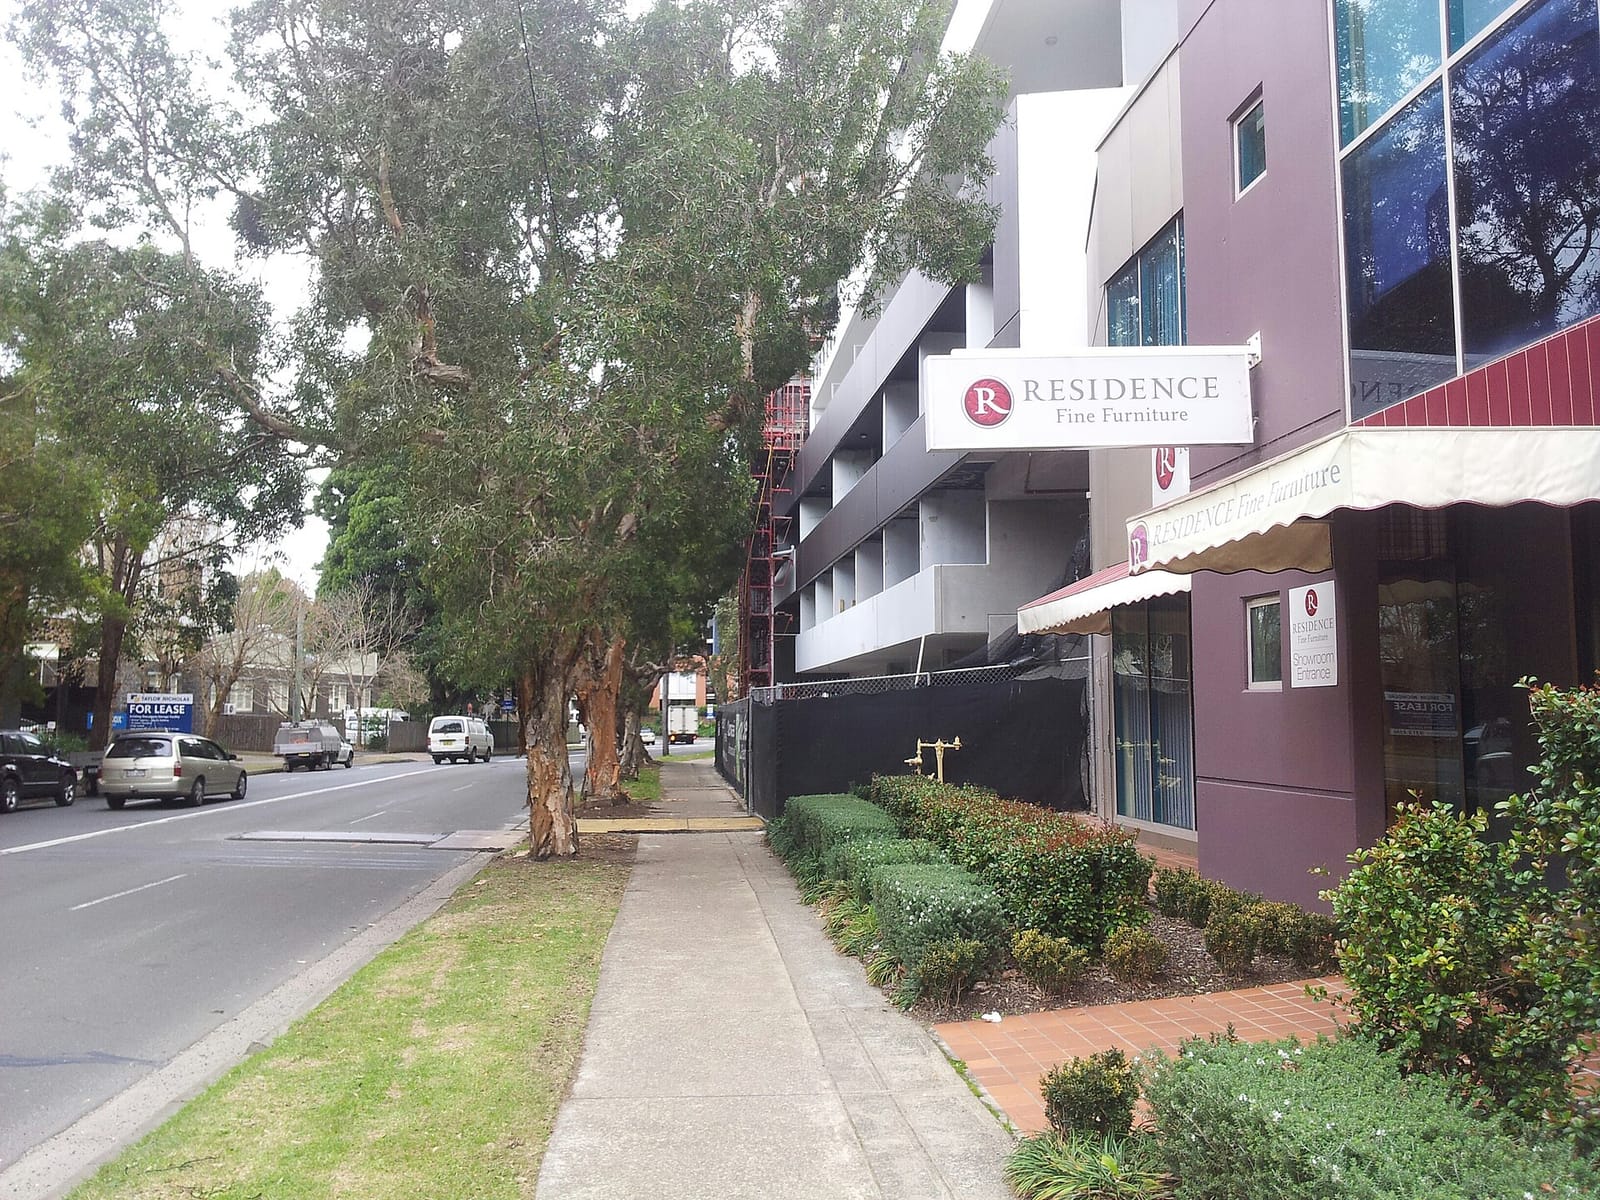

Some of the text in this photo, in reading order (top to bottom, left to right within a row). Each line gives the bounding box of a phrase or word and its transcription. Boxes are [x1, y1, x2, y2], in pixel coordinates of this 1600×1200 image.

[973, 376, 1221, 415] R RESIDENCE
[1056, 406, 1189, 424] Fine Furniture
[1153, 497, 1235, 546] RESIDENCE
[1237, 492, 1265, 520] Fine
[1267, 463, 1341, 508] Furniture
[1292, 617, 1334, 634] RESIDENCE
[1297, 633, 1328, 645] Fine Furniture
[1293, 651, 1335, 667] Showroom
[1297, 666, 1331, 681] Entrance
[129, 704, 185, 714] FOR LEASE
